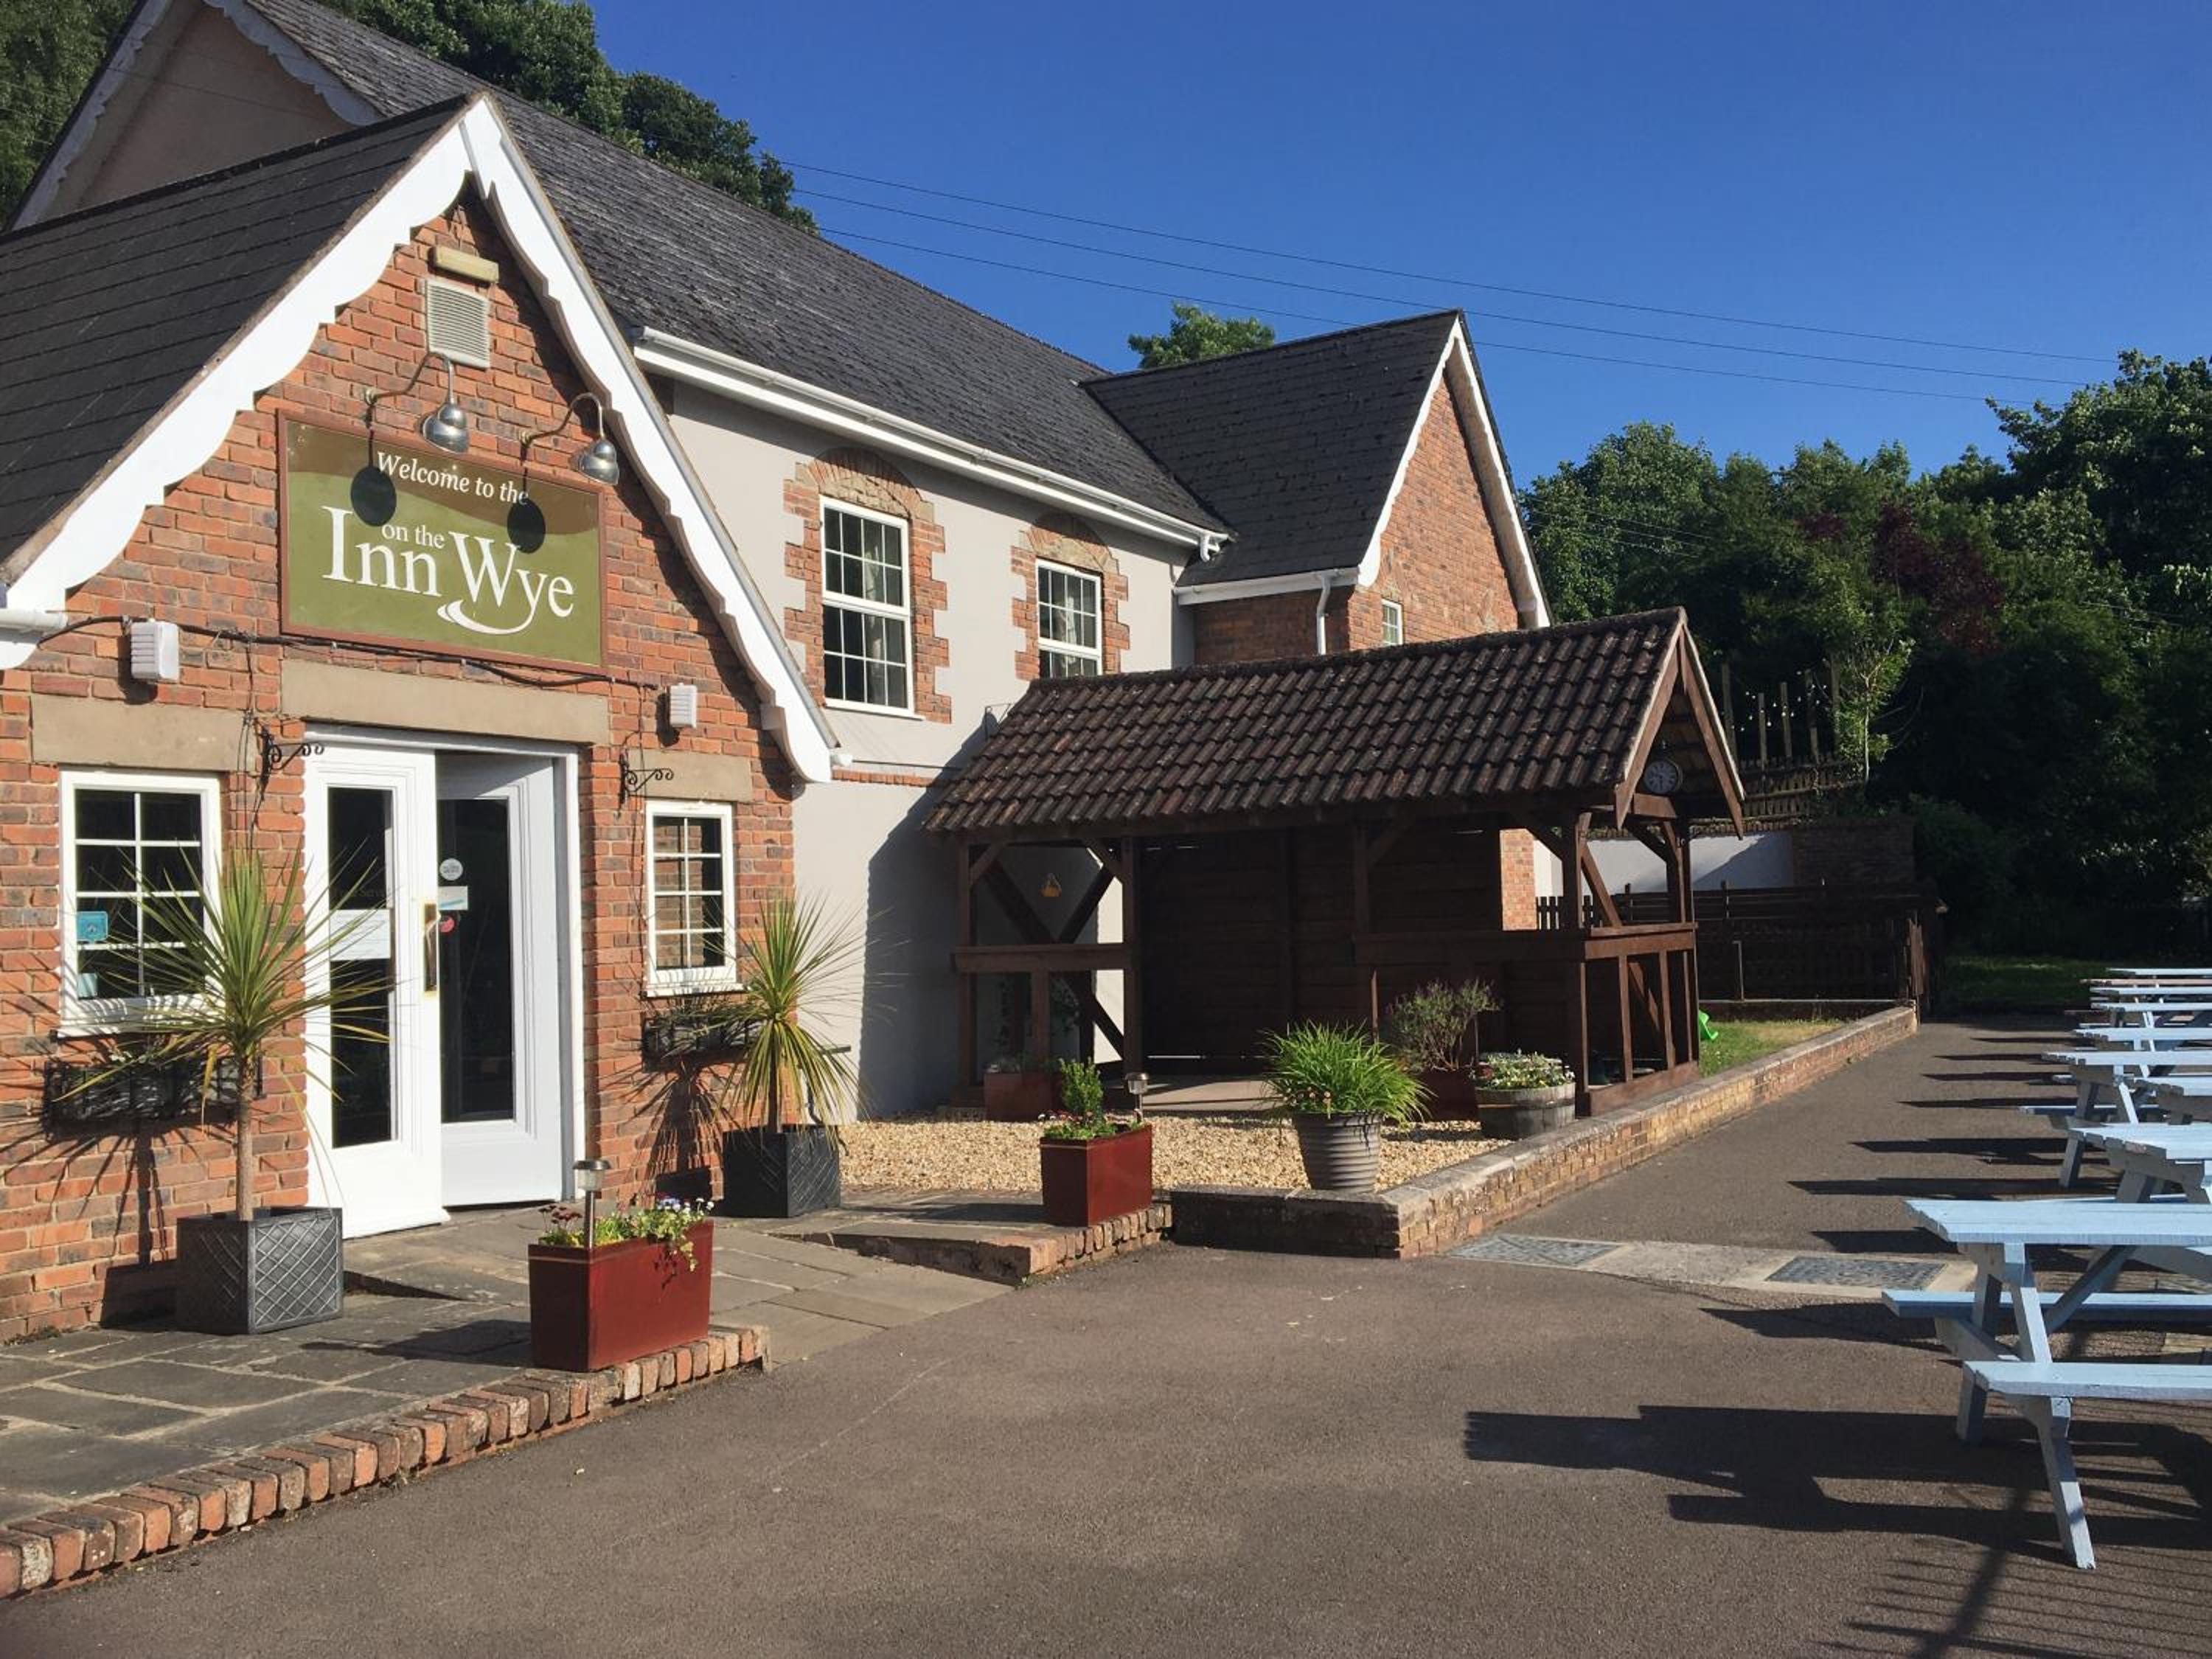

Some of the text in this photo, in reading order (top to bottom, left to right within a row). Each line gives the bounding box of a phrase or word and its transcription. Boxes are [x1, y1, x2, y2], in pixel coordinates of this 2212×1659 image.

[378, 451, 529, 505] Welcome to the
[382, 524, 445, 549] on the
[321, 505, 574, 634] Inn Wye
